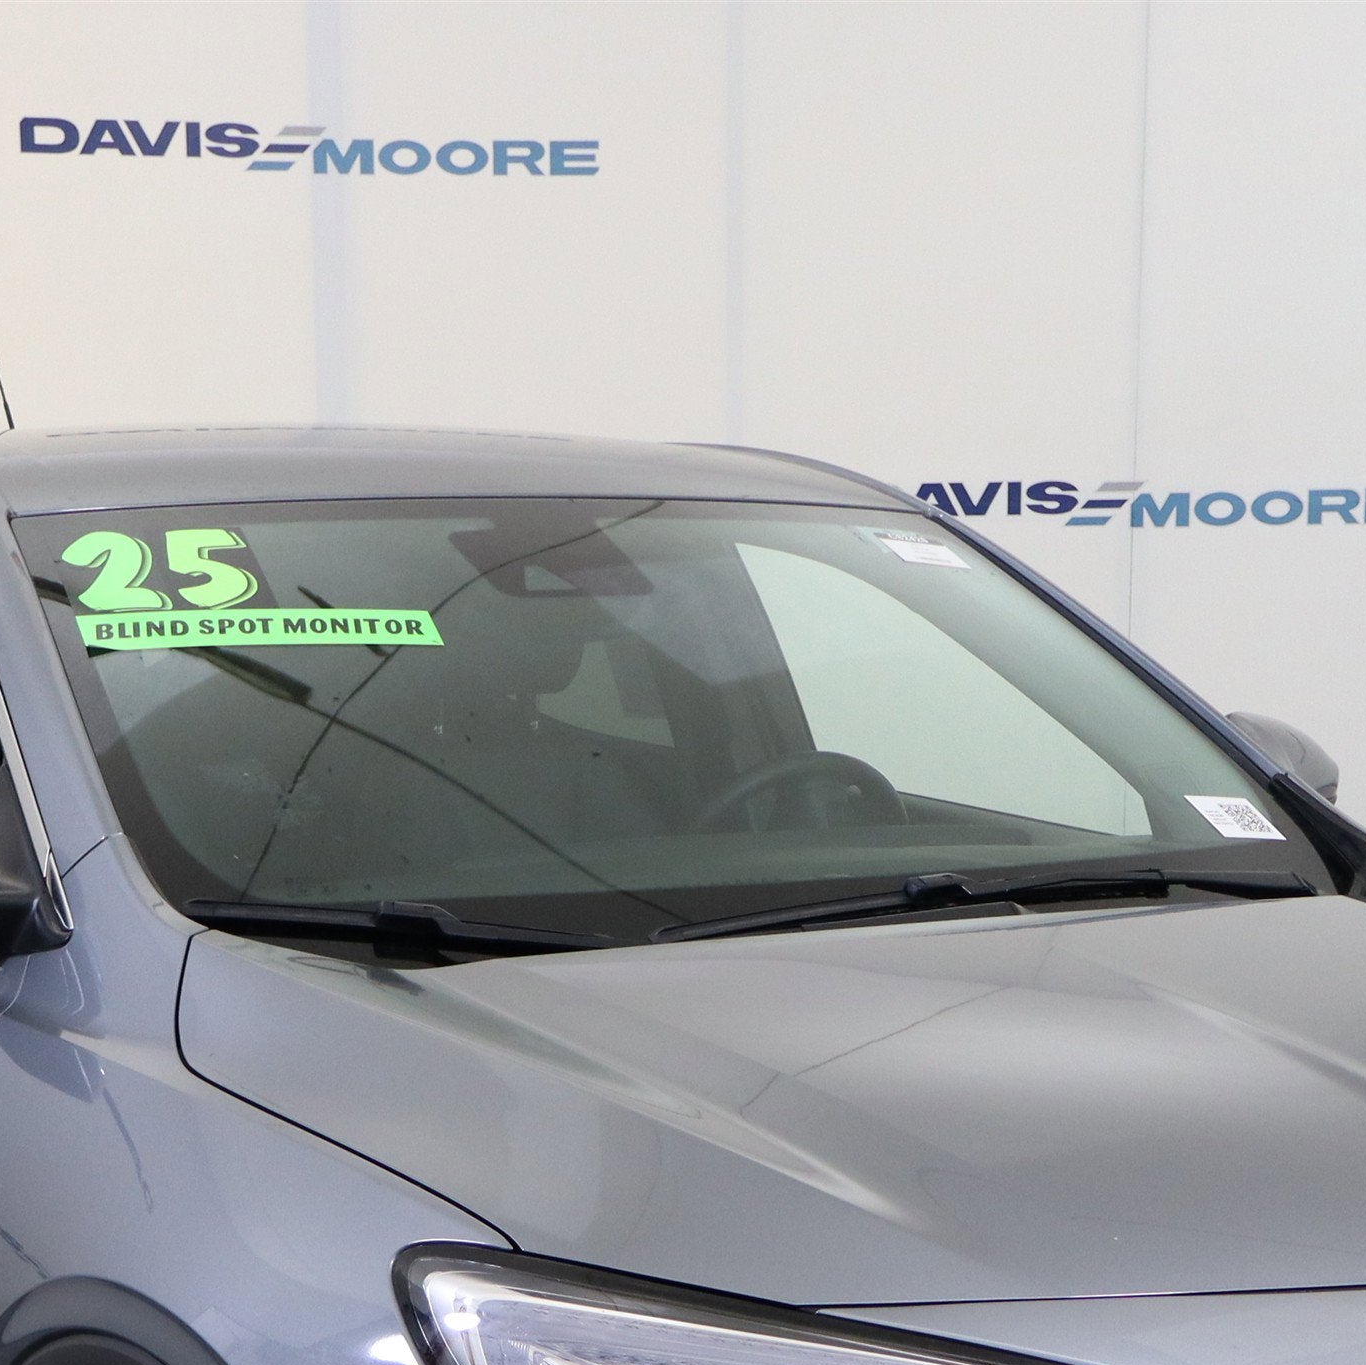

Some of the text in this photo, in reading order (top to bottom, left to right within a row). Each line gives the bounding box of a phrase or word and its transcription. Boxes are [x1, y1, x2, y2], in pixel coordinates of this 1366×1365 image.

[18, 116, 600, 176] DAVIS MOORE
[61, 528, 259, 612] 25
[95, 617, 426, 641] BLIND SPOT MONITOR
